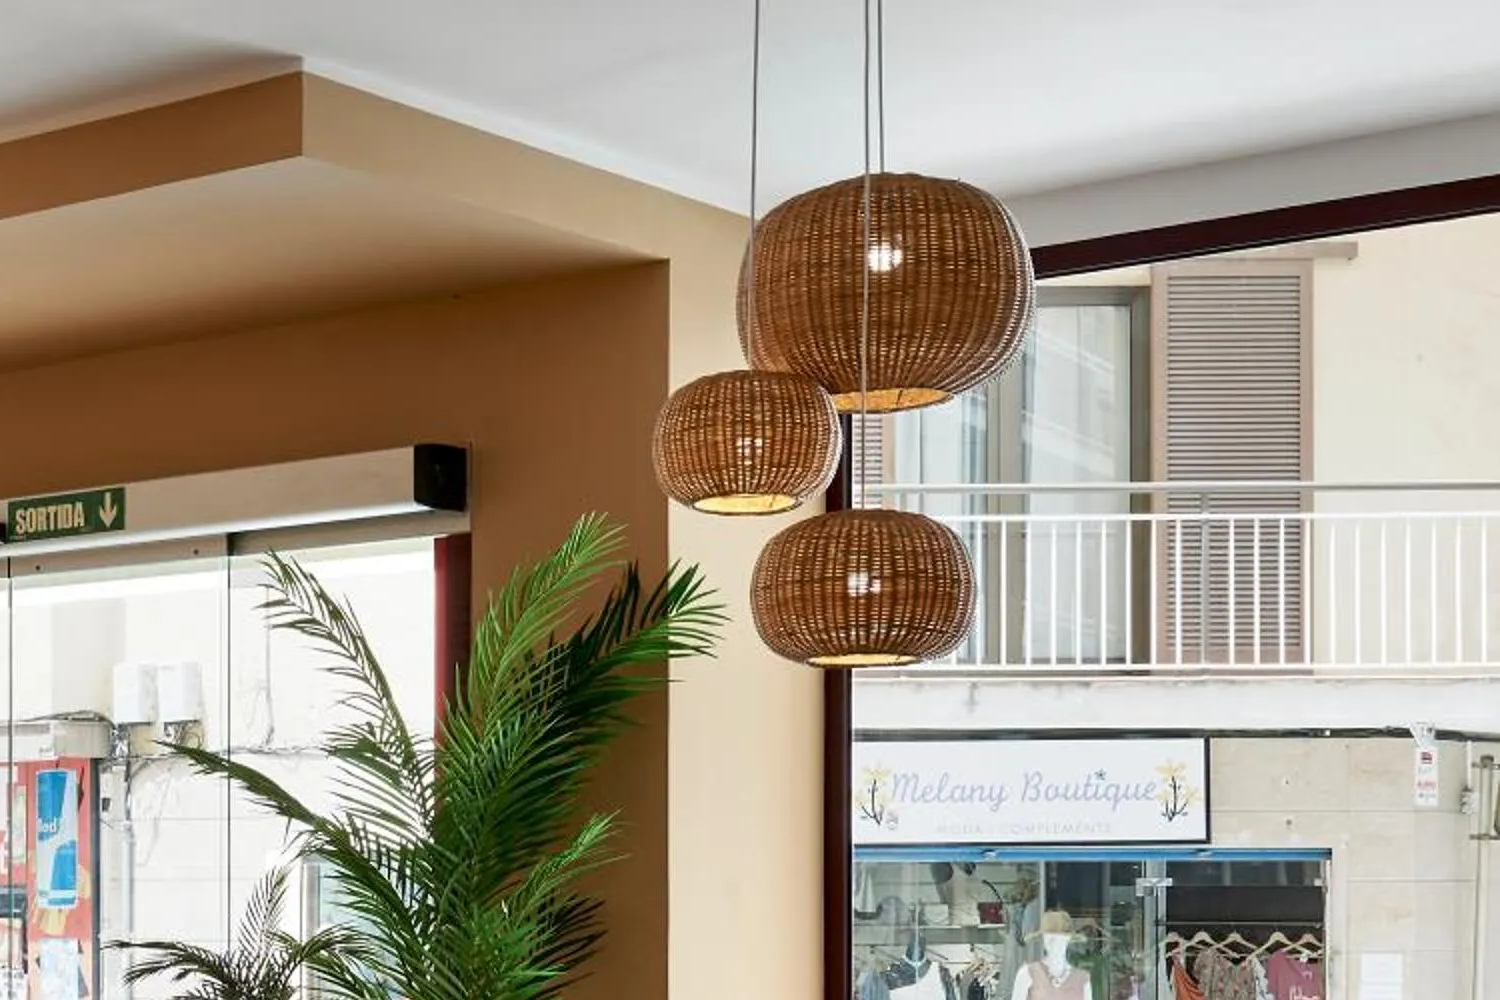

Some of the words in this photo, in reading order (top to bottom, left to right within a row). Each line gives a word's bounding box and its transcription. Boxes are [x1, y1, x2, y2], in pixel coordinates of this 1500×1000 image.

[15, 501, 85, 534] SORTIDA
[890, 771, 1010, 812] Melany
[1020, 769, 1157, 812] Boutique
